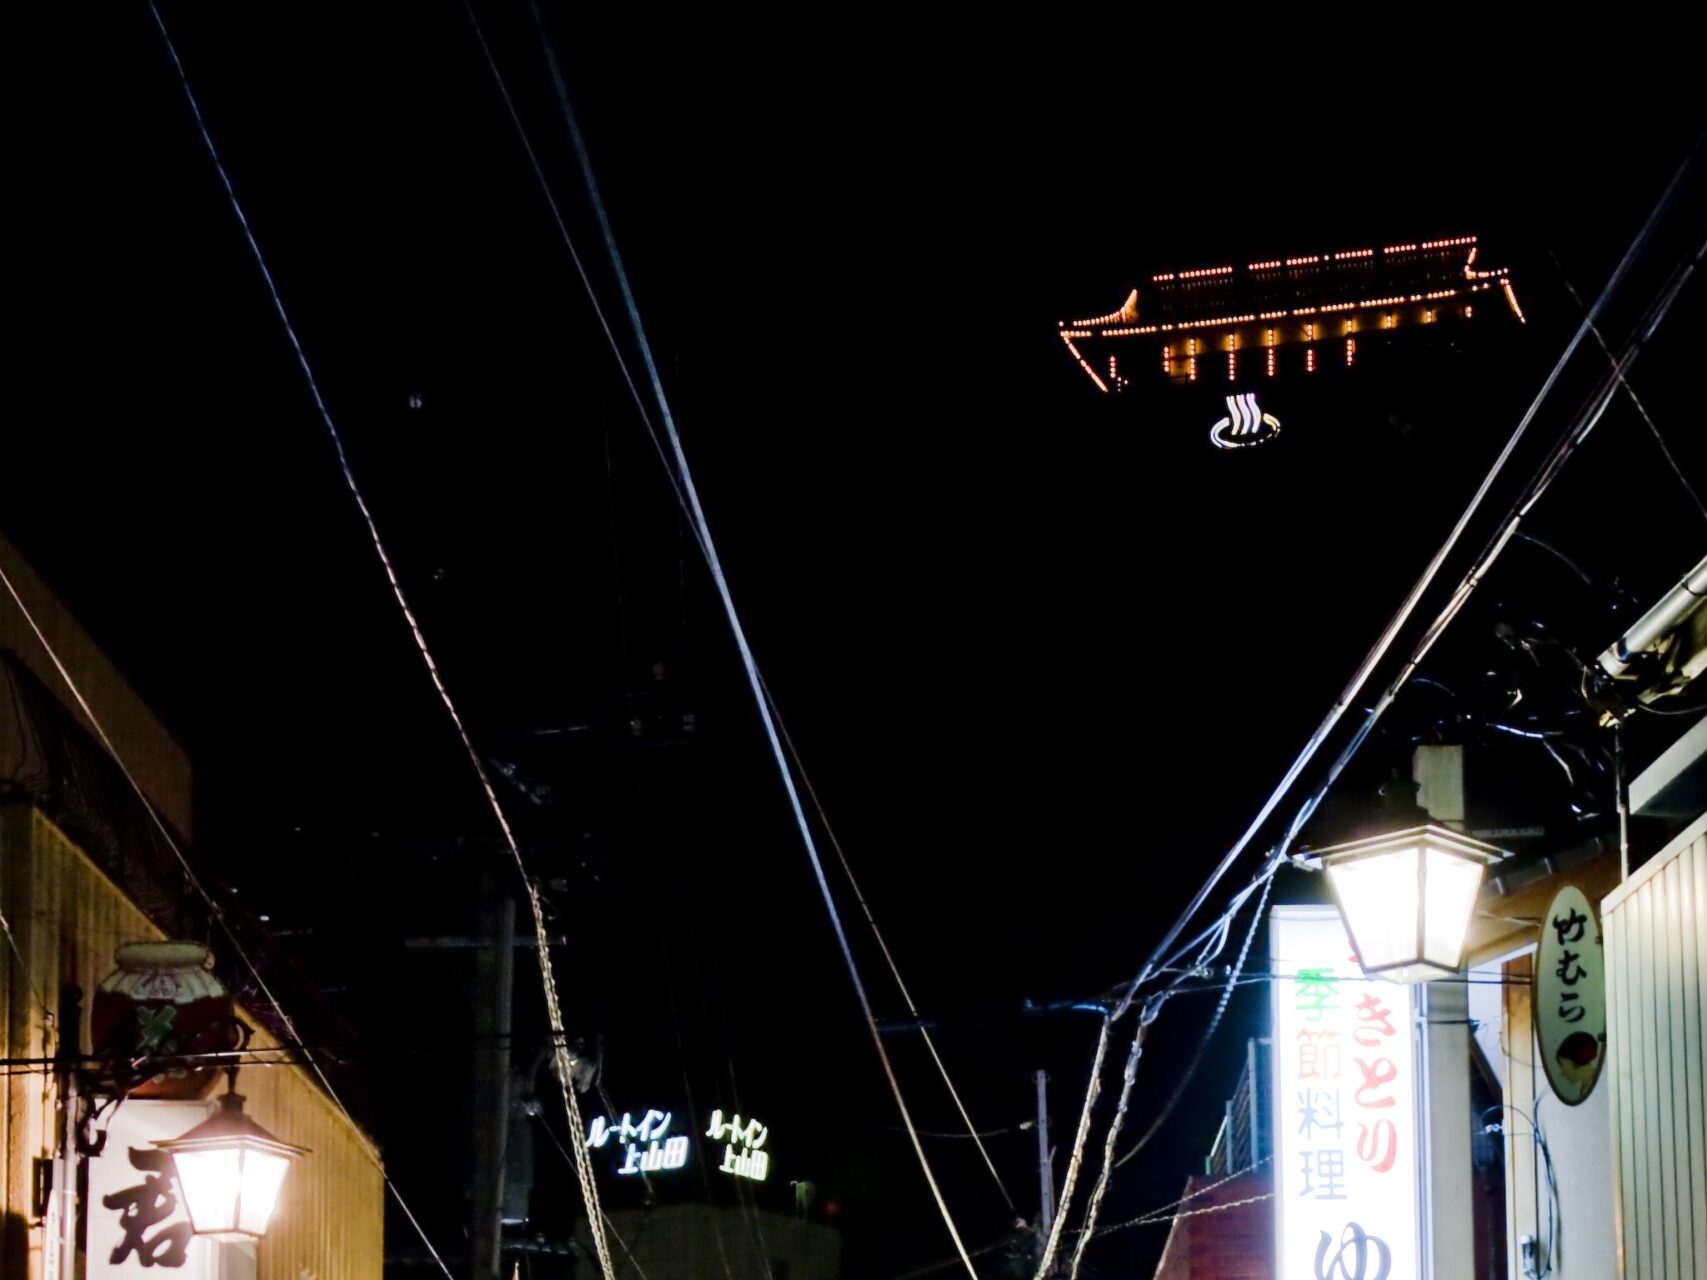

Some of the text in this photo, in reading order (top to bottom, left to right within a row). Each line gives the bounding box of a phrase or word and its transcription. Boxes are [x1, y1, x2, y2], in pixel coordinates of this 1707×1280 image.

[1348, 936, 1398, 1174] きとり
[1294, 966, 1349, 1201] 季節料理
[585, 1109, 672, 1148] ルートイン
[705, 1109, 768, 1149] ルートイン
[618, 1136, 689, 1174] 上山田
[719, 1143, 769, 1181] 上山田
